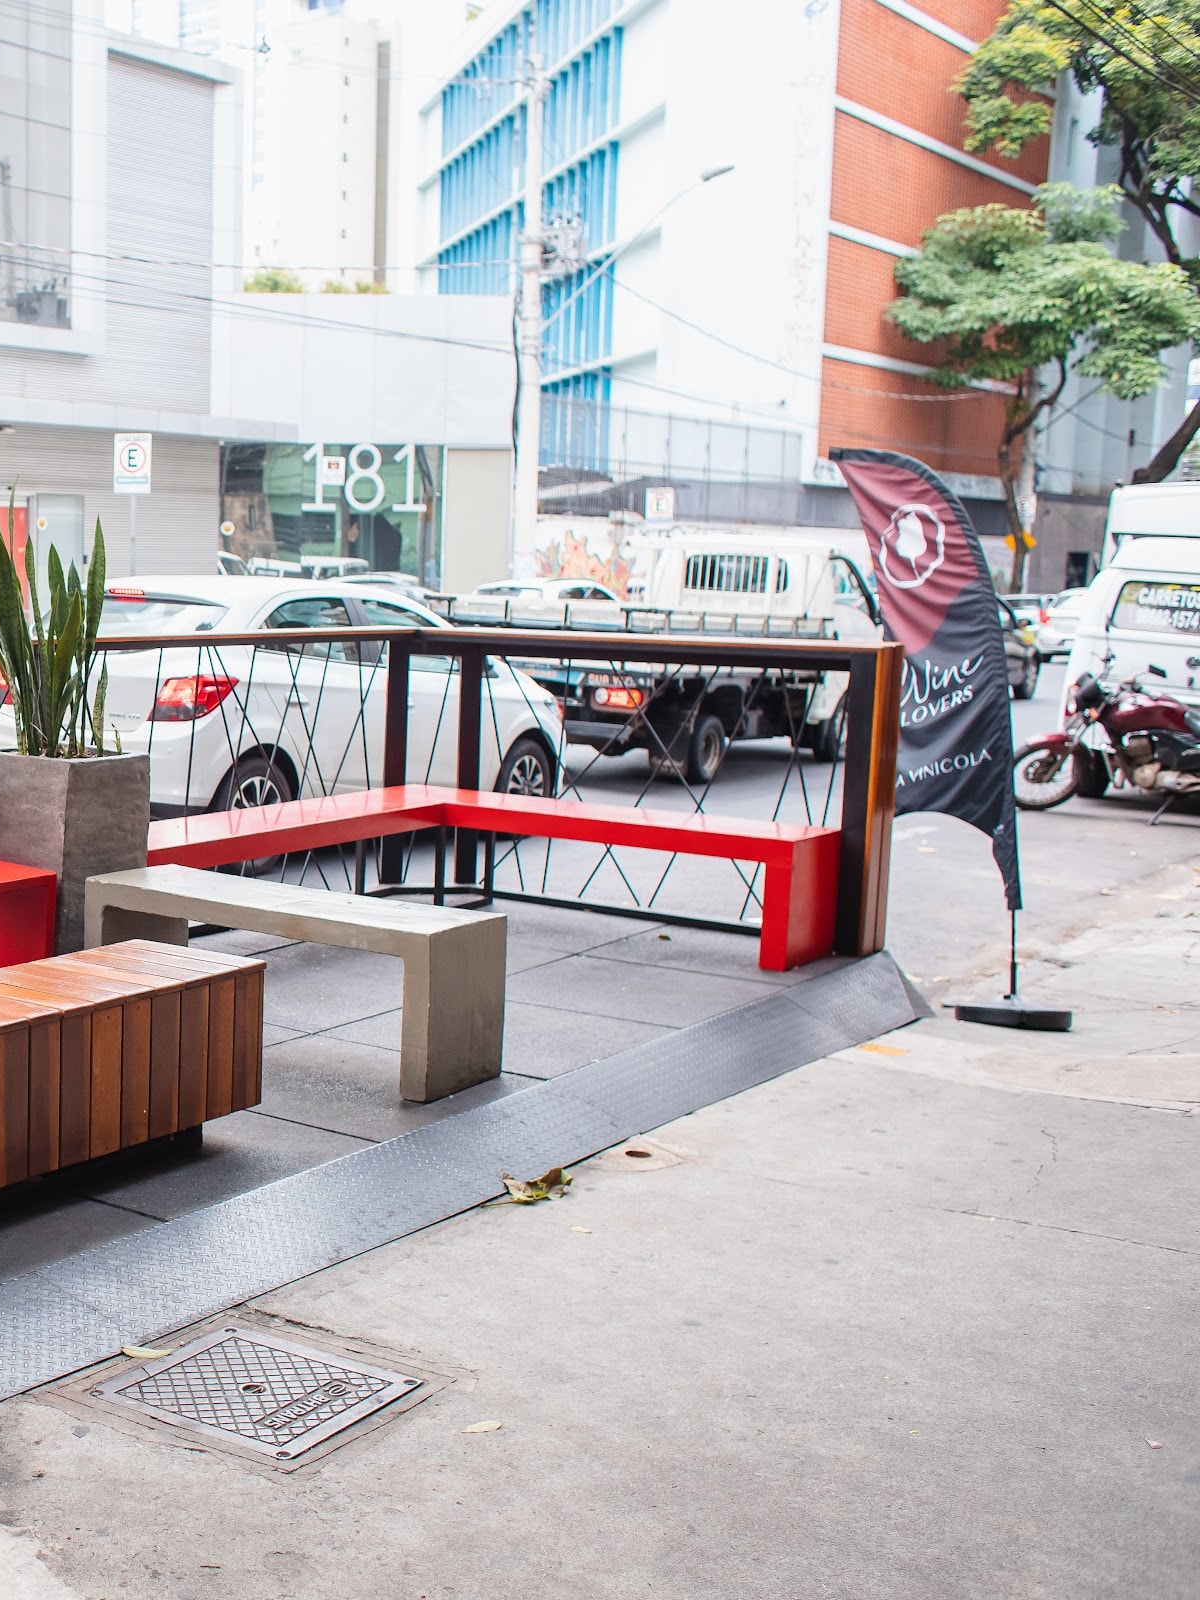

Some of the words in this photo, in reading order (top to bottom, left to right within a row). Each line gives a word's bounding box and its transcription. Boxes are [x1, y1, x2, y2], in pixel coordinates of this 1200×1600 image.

[128, 449, 138, 467] E
[301, 442, 427, 512] 181
[900, 655, 984, 707] Wine
[900, 684, 973, 728] LOVERS
[264, 1393, 331, 1431] BHTRANS
